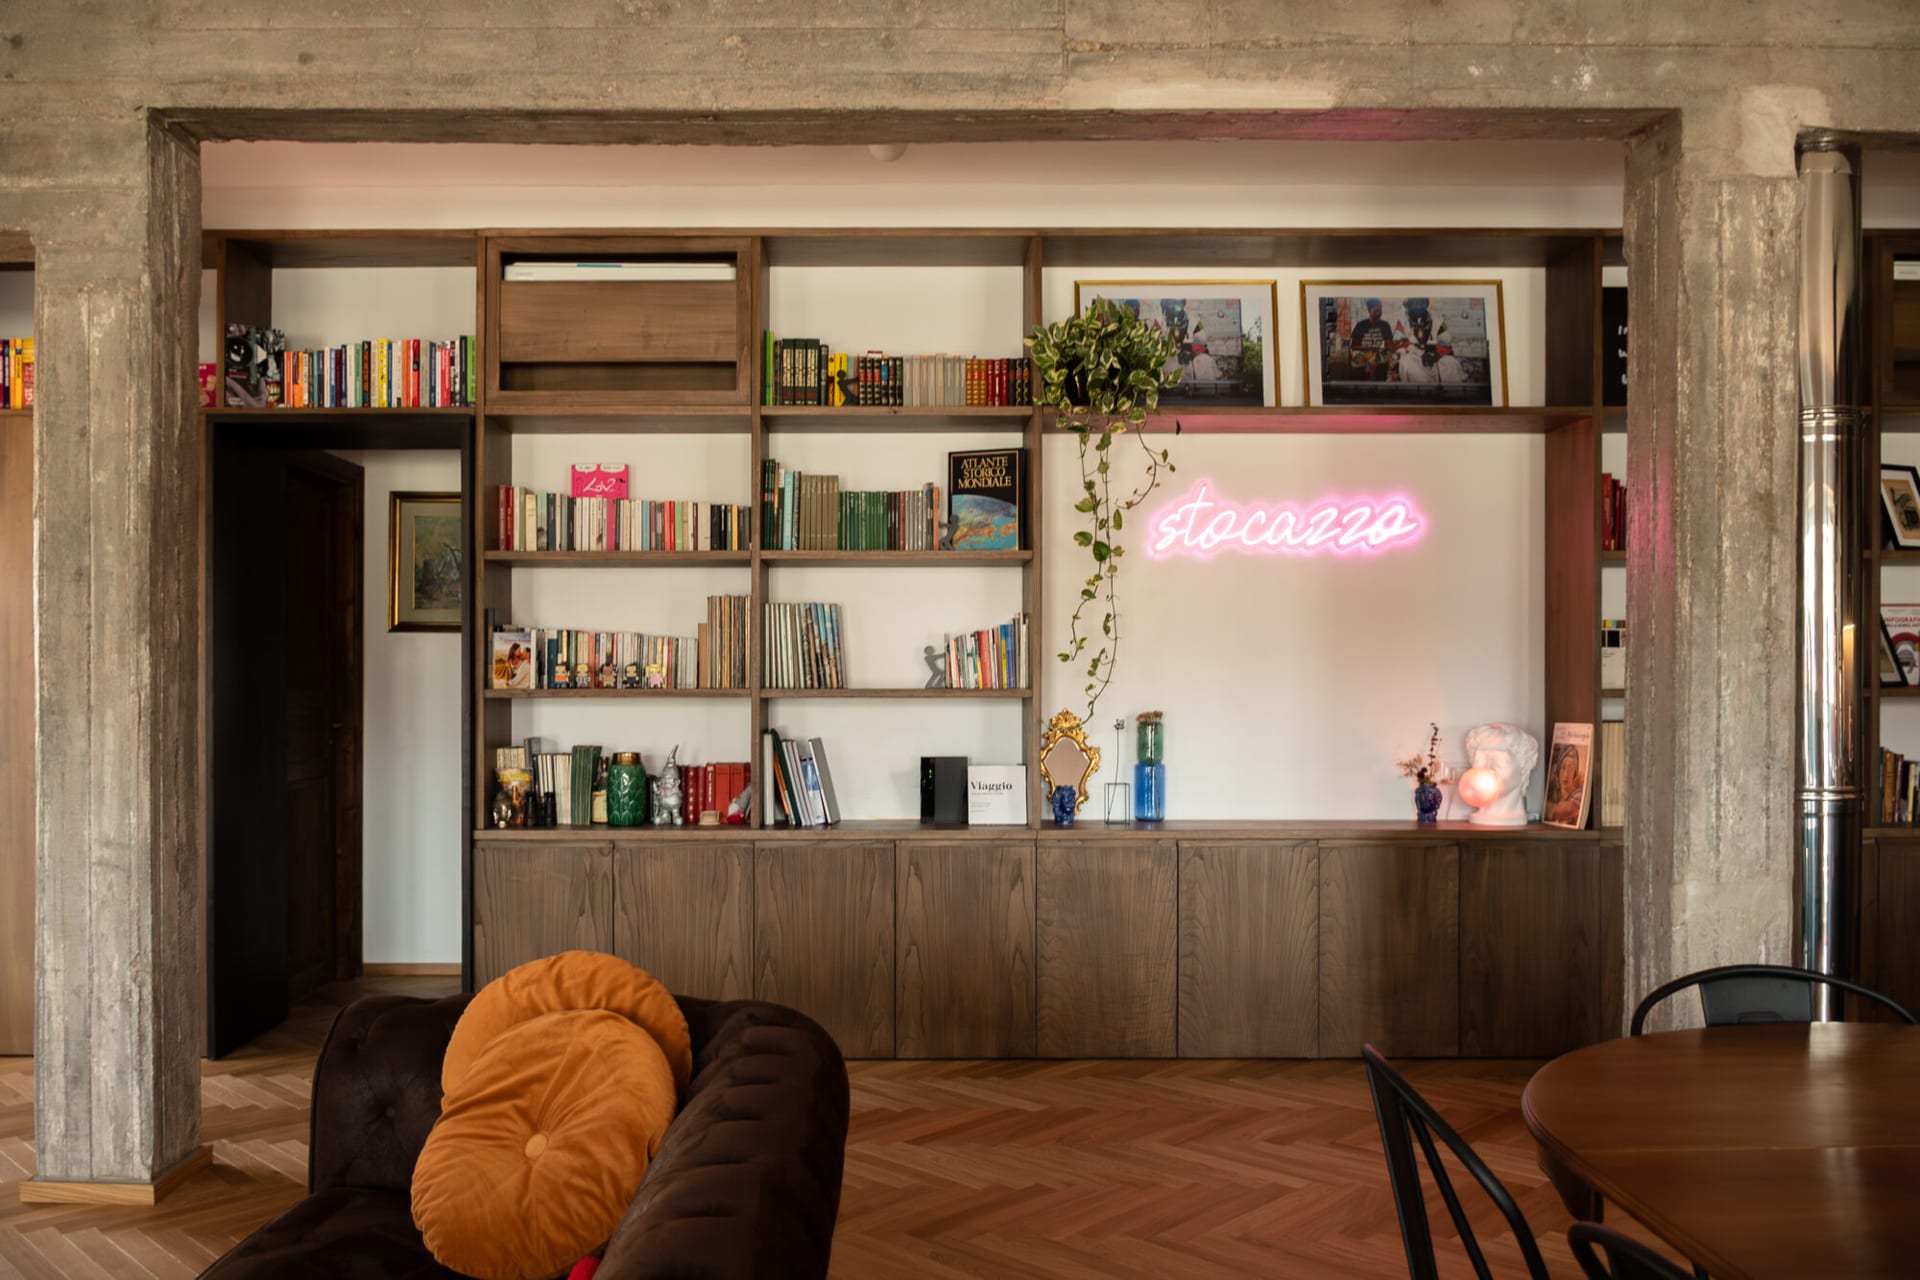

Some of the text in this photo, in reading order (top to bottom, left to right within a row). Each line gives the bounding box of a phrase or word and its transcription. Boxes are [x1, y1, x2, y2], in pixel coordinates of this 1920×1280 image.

[961, 456, 1008, 469] ATLANTE
[963, 466, 1006, 479] STORICO
[958, 476, 1012, 489] MONDIALE
[1154, 484, 1419, 550] stocazzo
[970, 780, 1013, 791] Viaggio
